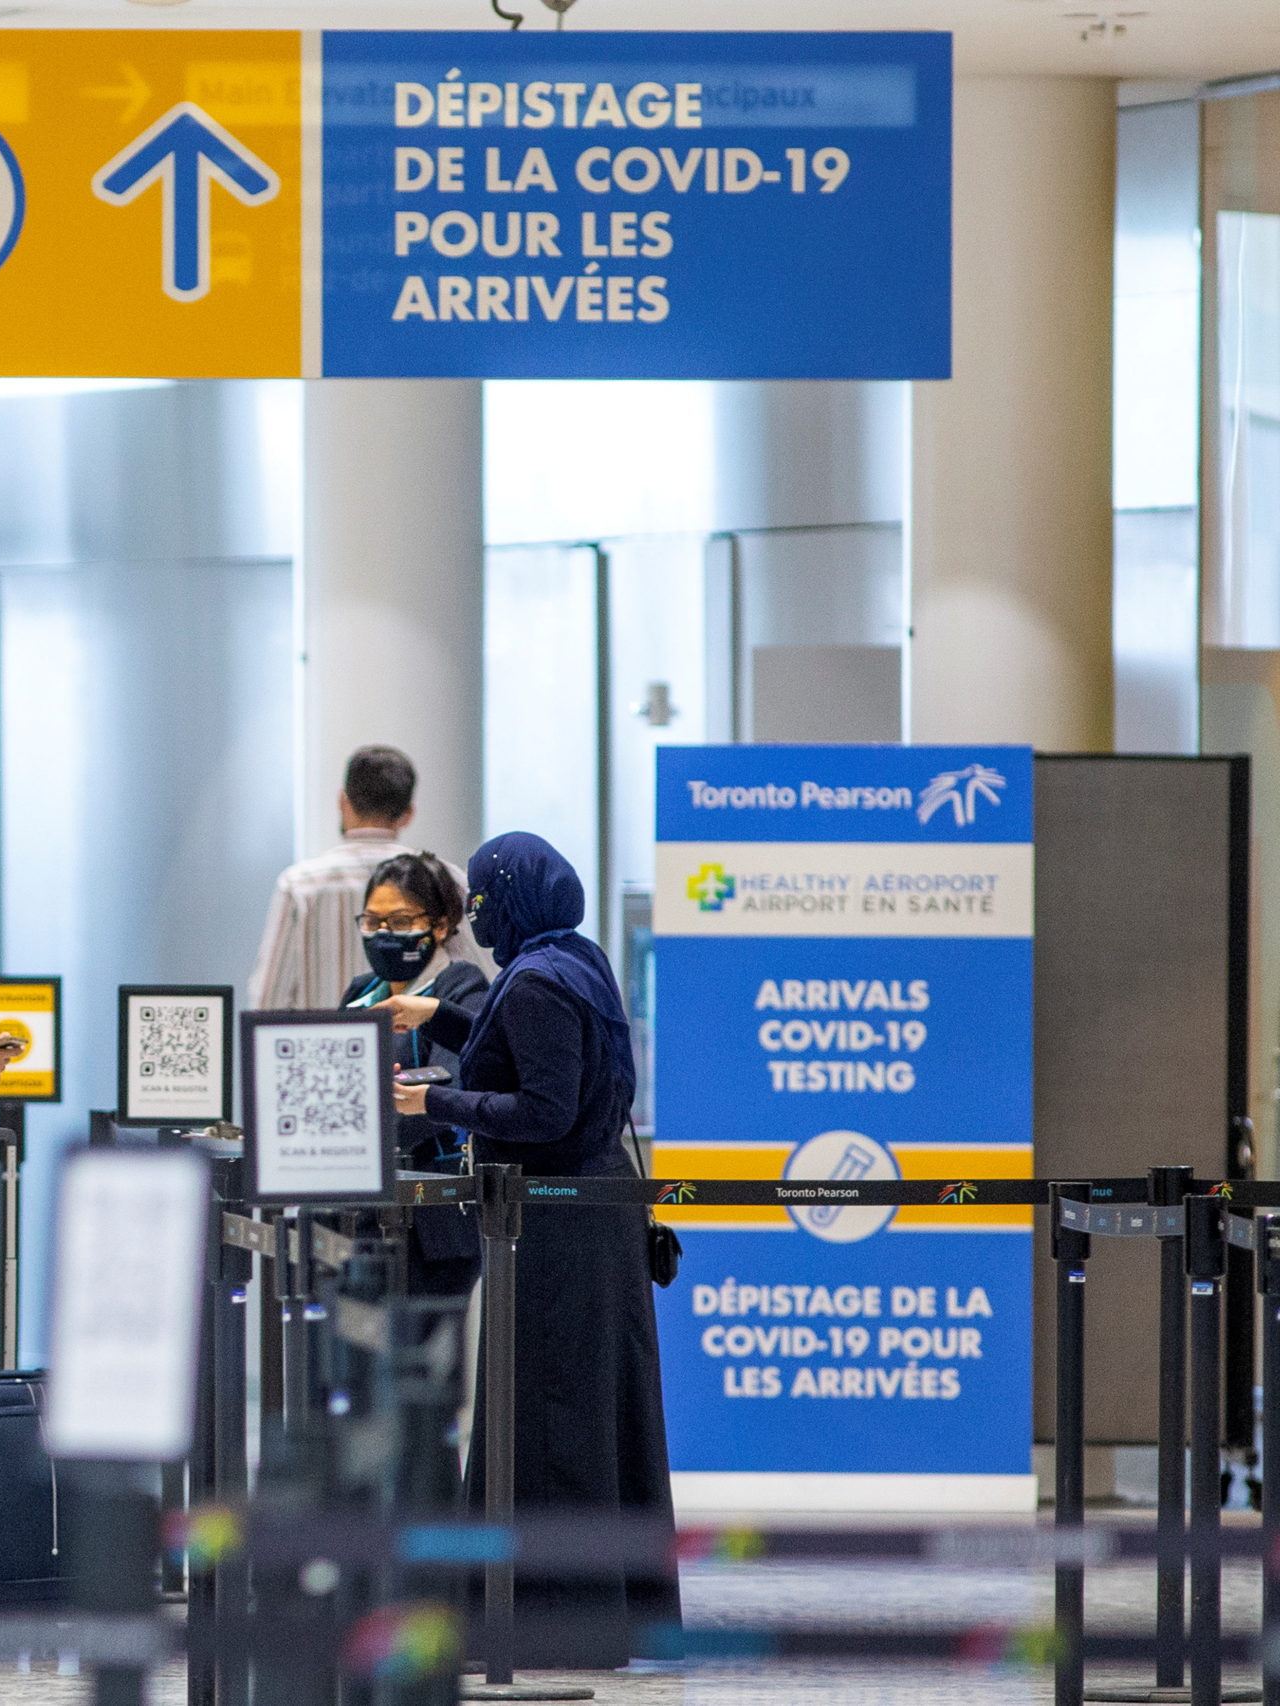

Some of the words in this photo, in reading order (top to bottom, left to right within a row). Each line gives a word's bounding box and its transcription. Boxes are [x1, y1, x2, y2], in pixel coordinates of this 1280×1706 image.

[395, 67, 703, 129] DÉPISTAGE
[395, 147, 465, 193] DE
[486, 147, 558, 193] LA
[576, 147, 851, 194] COVID-19
[395, 211, 562, 258] POUR
[582, 211, 674, 258] LES
[392, 263, 670, 323] ARRIVÉES
[687, 780, 797, 809] Toronto
[801, 781, 912, 809] Pearson
[740, 873, 850, 892] HEALTHY
[863, 870, 999, 892] AÉROPORT
[742, 895, 848, 913] AIRPORT
[862, 895, 897, 914] EN
[908, 894, 995, 914] SANTÉ
[755, 979, 930, 1011] ARRIVALS
[758, 1020, 927, 1052] COVID-19
[768, 1061, 916, 1093] TESTING
[528, 1184, 578, 1196] welcome
[775, 1186, 817, 1198] Toronto
[817, 1186, 859, 1198] Pearson
[693, 1277, 882, 1317] DÉPISTAGE
[892, 1286, 937, 1317] DE
[946, 1286, 993, 1317] LA
[702, 1326, 870, 1358] COVID-19
[879, 1327, 982, 1358] POUR
[724, 1367, 782, 1398] LES
[791, 1360, 961, 1399] ARRIVÉES
